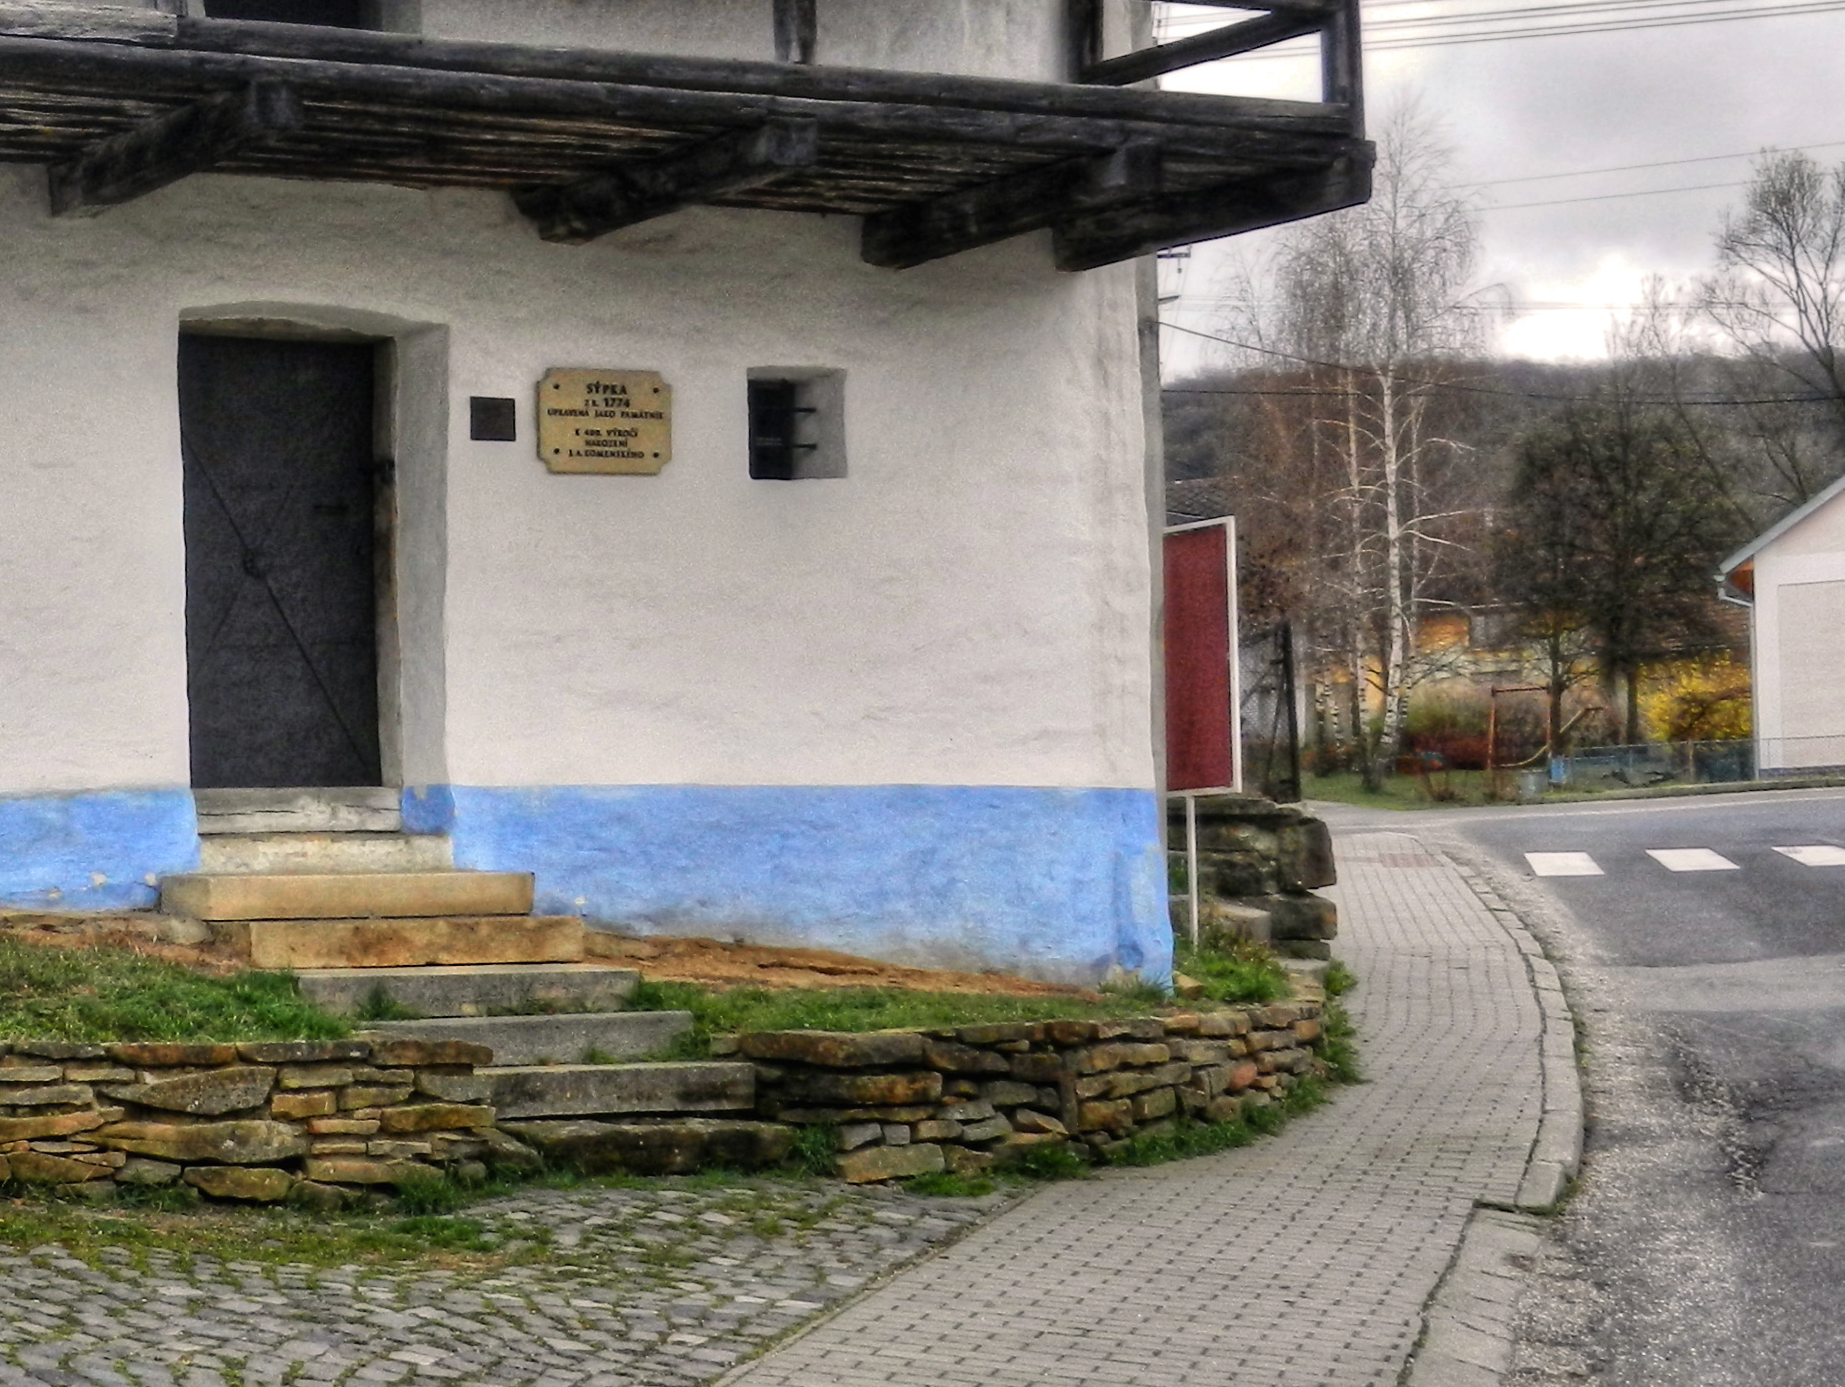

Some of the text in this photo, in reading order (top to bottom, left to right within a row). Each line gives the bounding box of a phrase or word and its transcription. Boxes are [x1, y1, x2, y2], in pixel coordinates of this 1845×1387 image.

[586, 380, 627, 395] SÝPKA
[604, 398, 630, 408] 1774
[594, 410, 616, 418] JAKO
